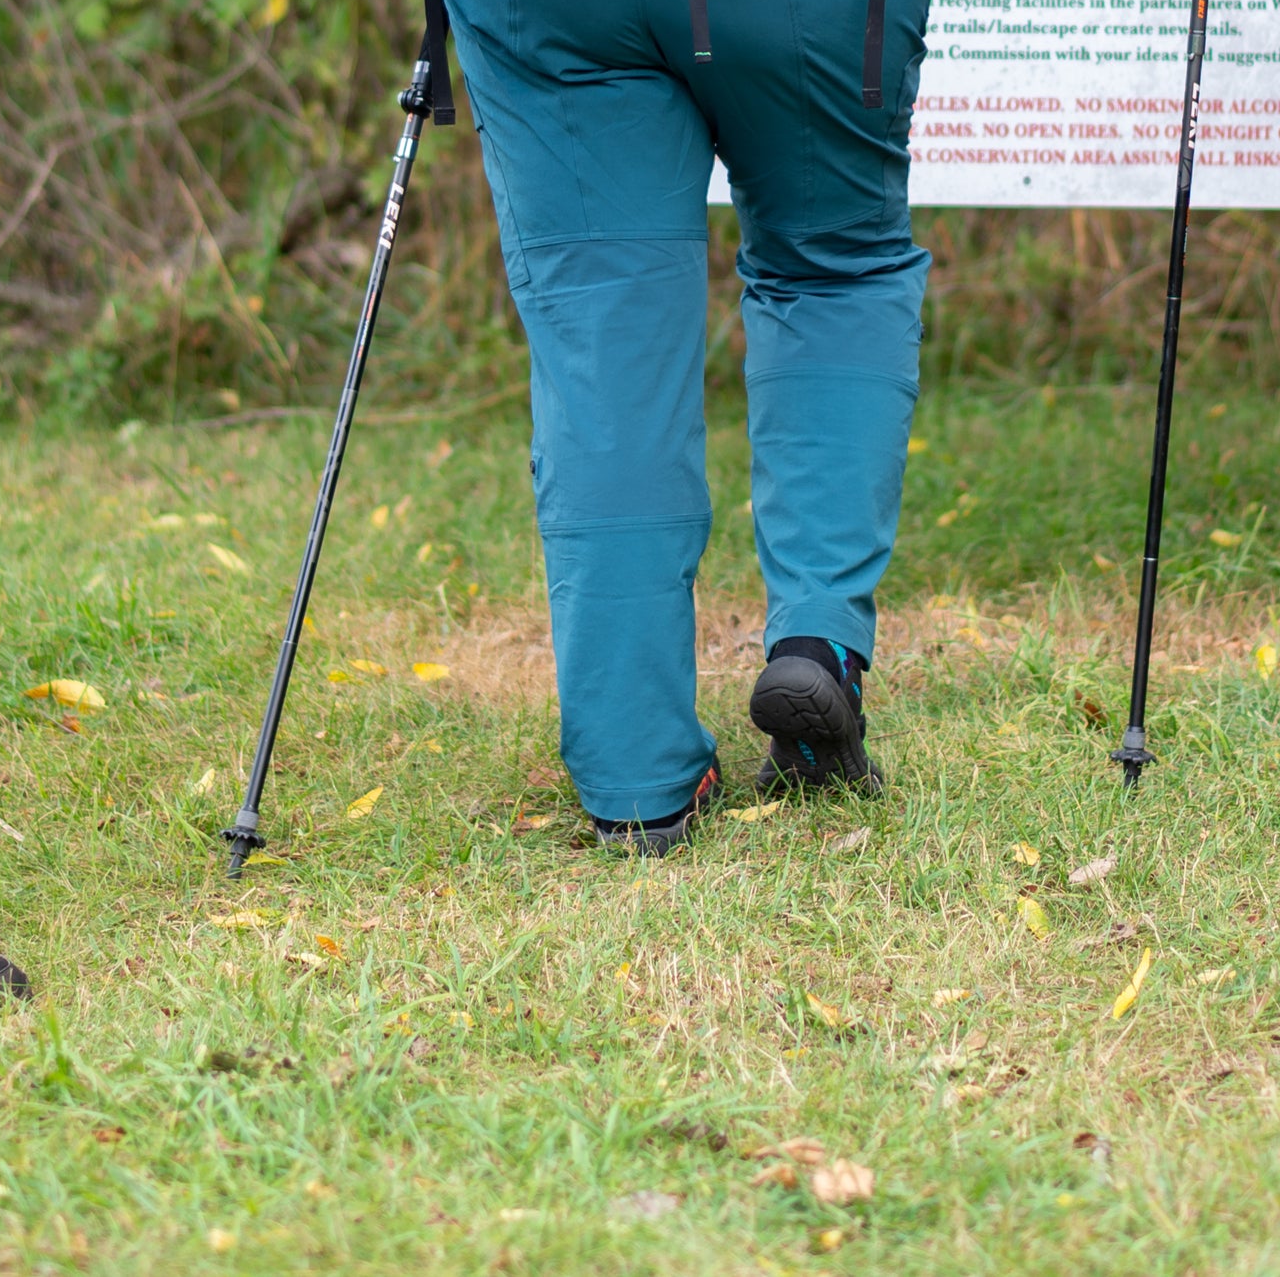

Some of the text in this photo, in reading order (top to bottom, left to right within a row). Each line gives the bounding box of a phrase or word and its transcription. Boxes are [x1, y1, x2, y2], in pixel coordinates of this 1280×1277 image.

[1210, 0, 1242, 11] area
[1247, 0, 1267, 12] on
[943, 19, 1078, 38] trails/landscape
[1082, 24, 1100, 36] or
[1104, 22, 1154, 37] create
[1158, 25, 1189, 37] new
[949, 44, 1051, 61] Commission
[1055, 45, 1090, 61] with
[1095, 50, 1132, 65] your
[1136, 47, 1179, 62] ideas
[974, 96, 1065, 112] ALLOWED.
[1075, 97, 1102, 112] NO
[1198, 99, 1224, 114] OR
[923, 123, 978, 138] ARMS.
[982, 123, 1010, 138] NO
[1014, 123, 1063, 139] OPEN
[1068, 124, 1123, 139] FIRES.
[1132, 124, 1160, 140] NO
[926, 147, 1065, 164] CONSERVATION
[1070, 149, 1116, 165] AREA
[1120, 149, 1180, 166] ASSUM
[1197, 151, 1229, 166] ALL
[379, 182, 405, 251] LEKI
